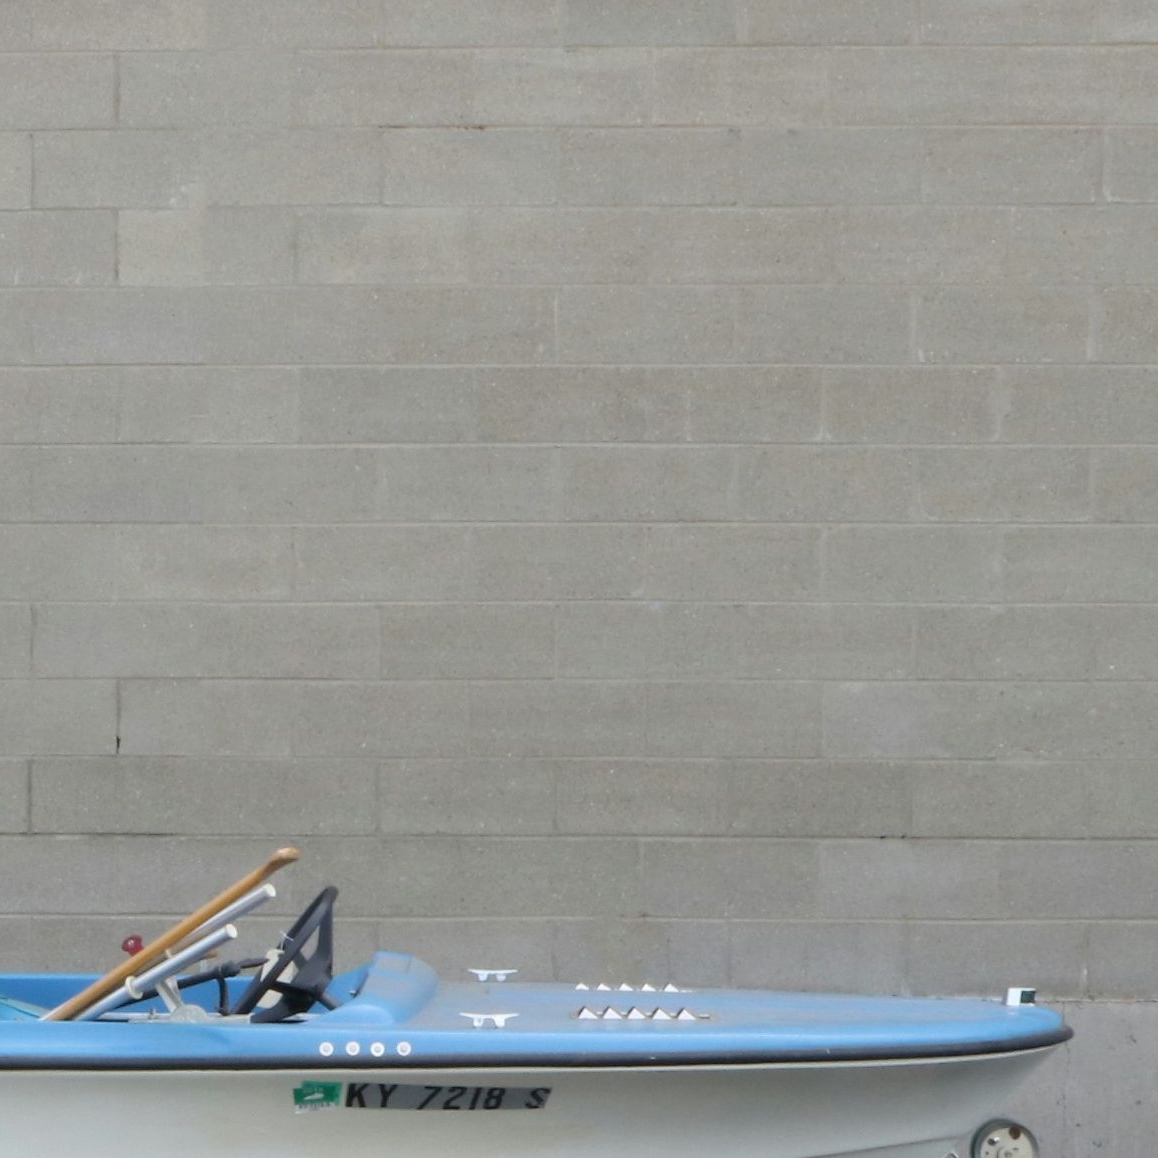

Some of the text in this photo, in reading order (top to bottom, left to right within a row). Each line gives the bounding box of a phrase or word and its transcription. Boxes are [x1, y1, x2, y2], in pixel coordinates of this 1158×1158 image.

[345, 1083, 552, 1110] KY 7218 S
